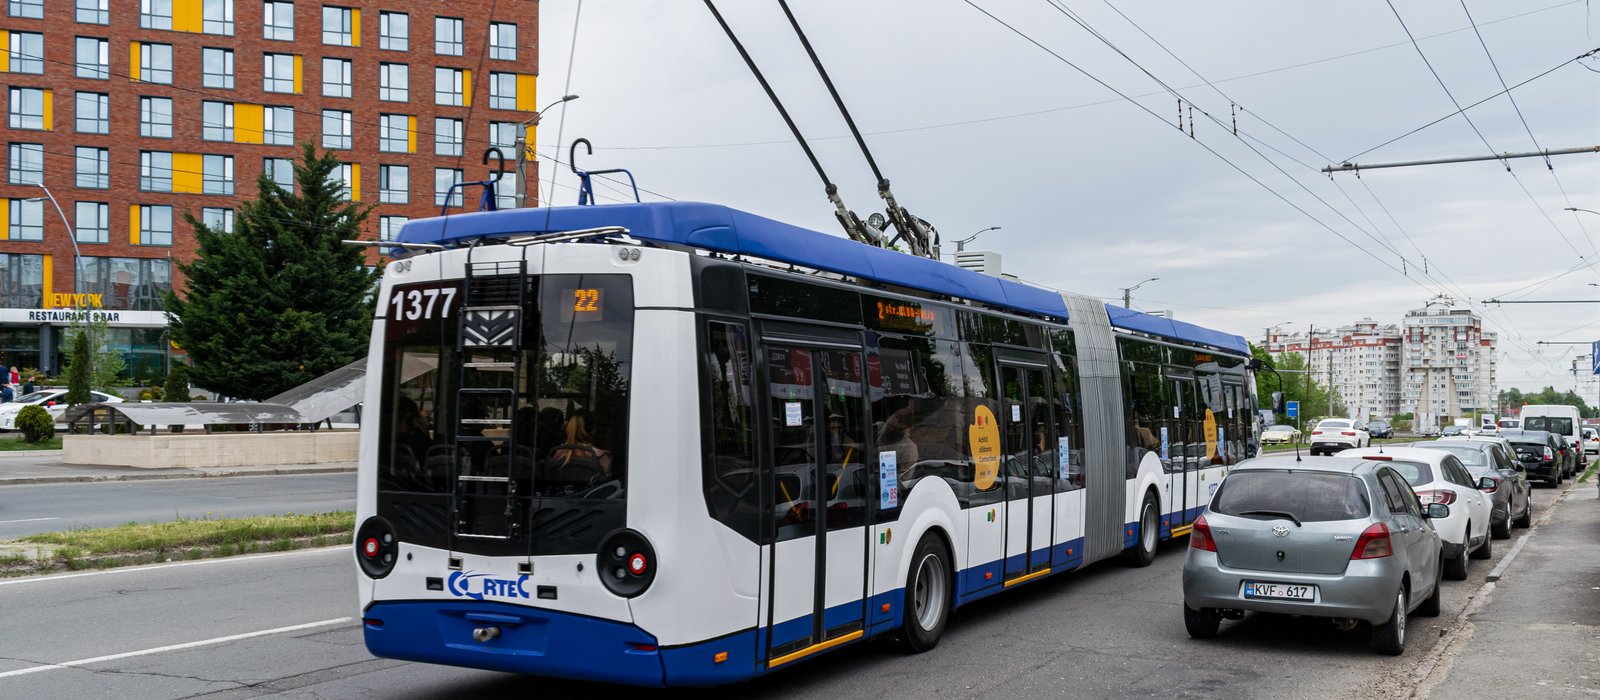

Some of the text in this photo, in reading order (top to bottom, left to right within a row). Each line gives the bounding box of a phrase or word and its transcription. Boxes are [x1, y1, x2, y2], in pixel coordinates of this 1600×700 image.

[46, 292, 103, 308] NEW YORK
[391, 287, 457, 321] 1377
[575, 289, 599, 312] 22
[29, 311, 90, 321] RESTAURANT
[101, 312, 120, 322] BAR
[1254, 584, 1277, 596] KVF
[1286, 586, 1308, 598] 617
